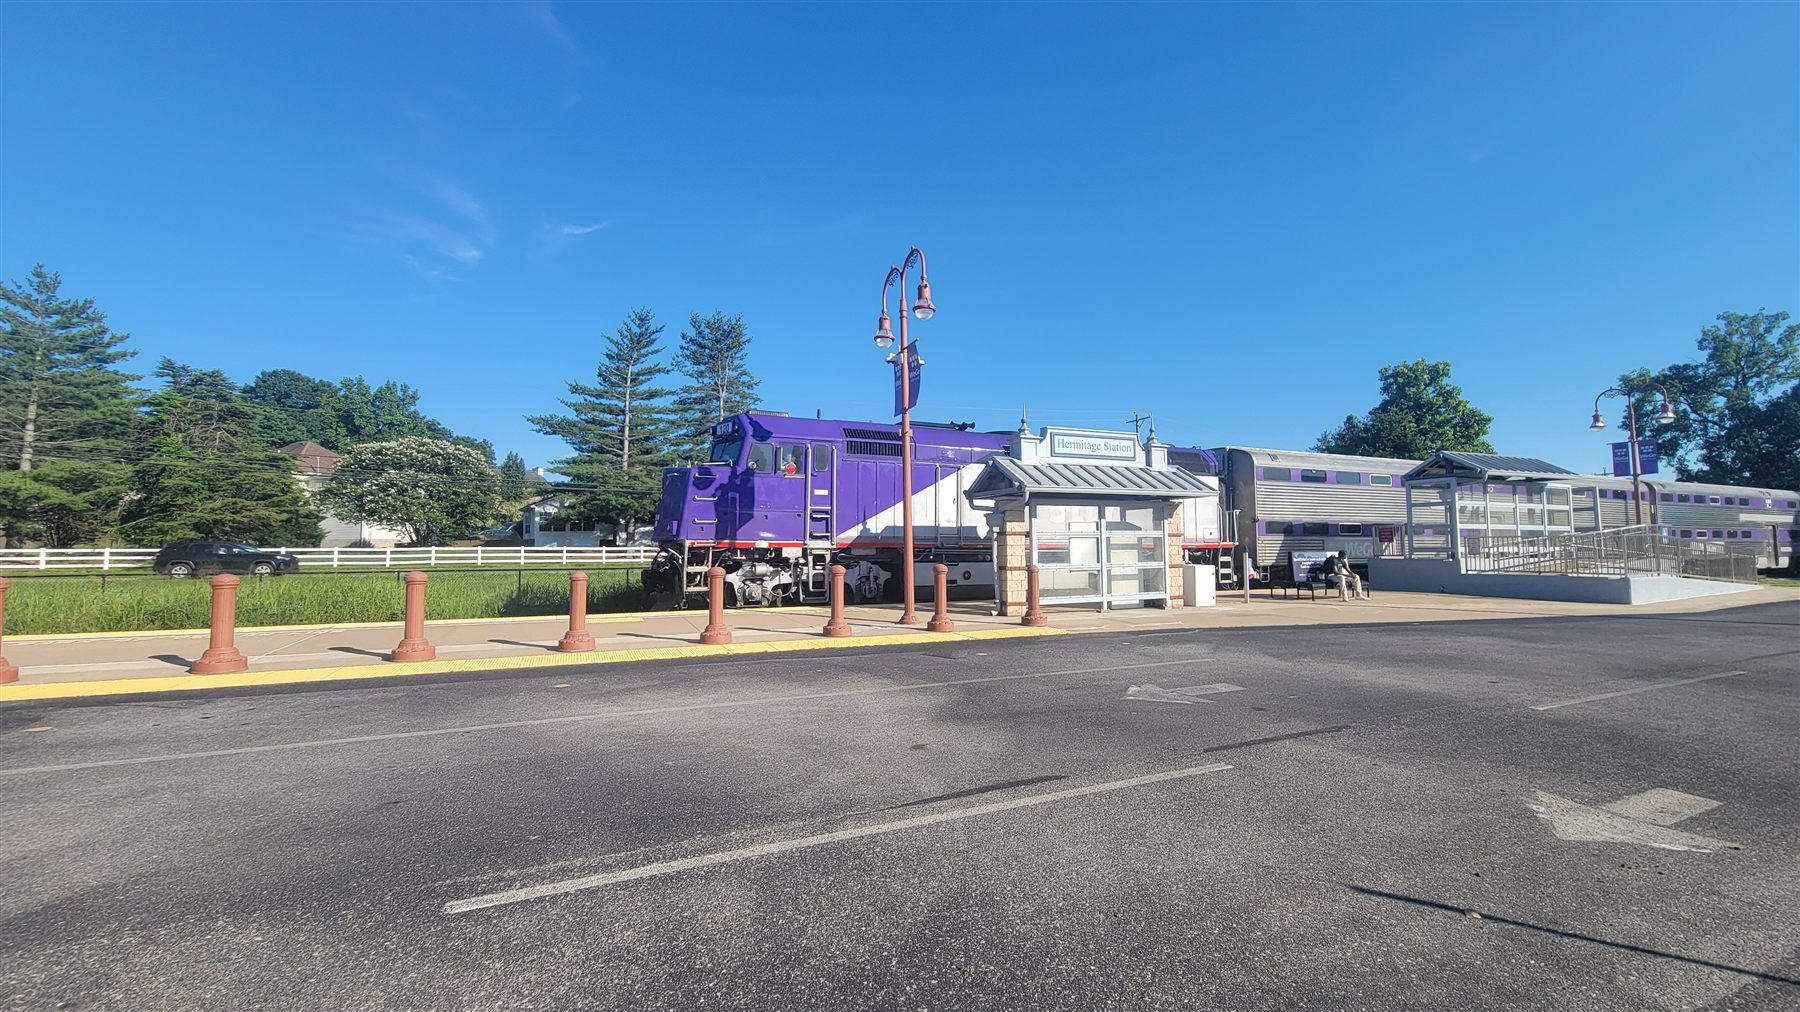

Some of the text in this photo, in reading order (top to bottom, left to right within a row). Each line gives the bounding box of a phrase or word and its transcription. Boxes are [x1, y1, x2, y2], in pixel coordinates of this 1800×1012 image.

[1057, 438, 1131, 453] Hermitage Station
[1345, 541, 1373, 558] WeG
